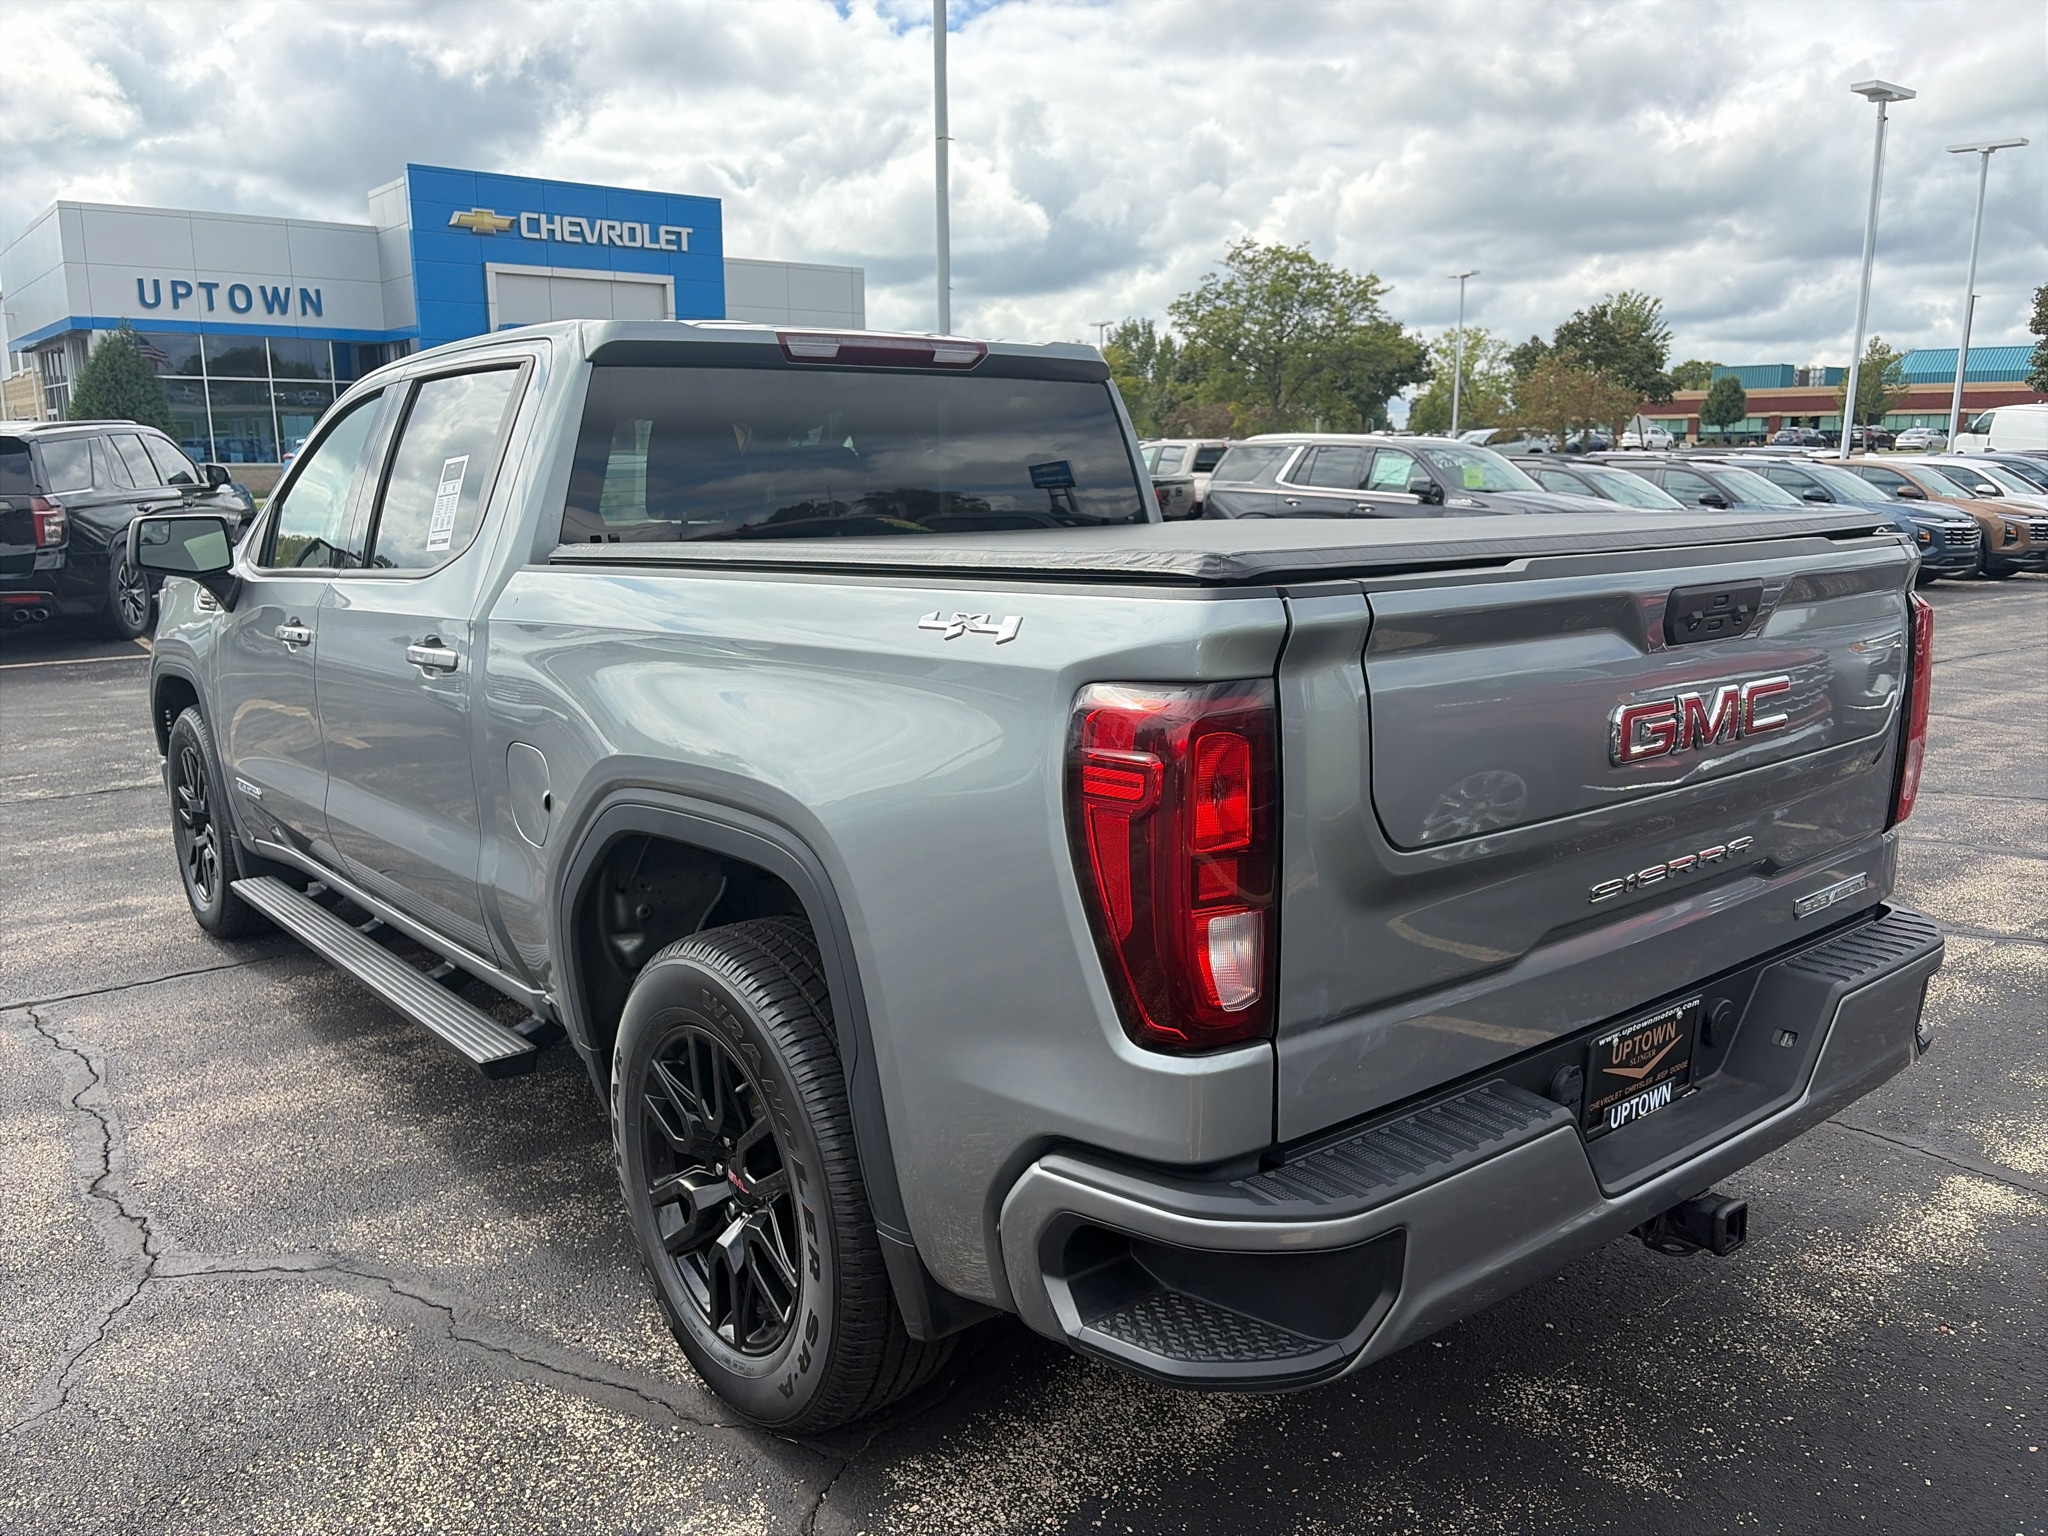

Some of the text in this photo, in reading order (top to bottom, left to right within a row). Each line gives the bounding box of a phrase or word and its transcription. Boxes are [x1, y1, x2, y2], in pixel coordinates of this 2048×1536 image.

[519, 211, 693, 252] CHEVROLET
[136, 277, 324, 317] UPTOWN
[1609, 675, 1791, 767] GMC
[1588, 835, 1754, 903] SIERRA
[1598, 999, 1700, 1046] www.uptownmotors.com
[1612, 1020, 1677, 1065] UPTOWN
[1629, 1048, 1657, 1066] SLINGER
[1589, 1060, 1689, 1112] CHEVROLET CHRYSLER JEEP DODGE
[1610, 1082, 1672, 1129] UPTOWN
[702, 988, 822, 1283] WRANGLER
